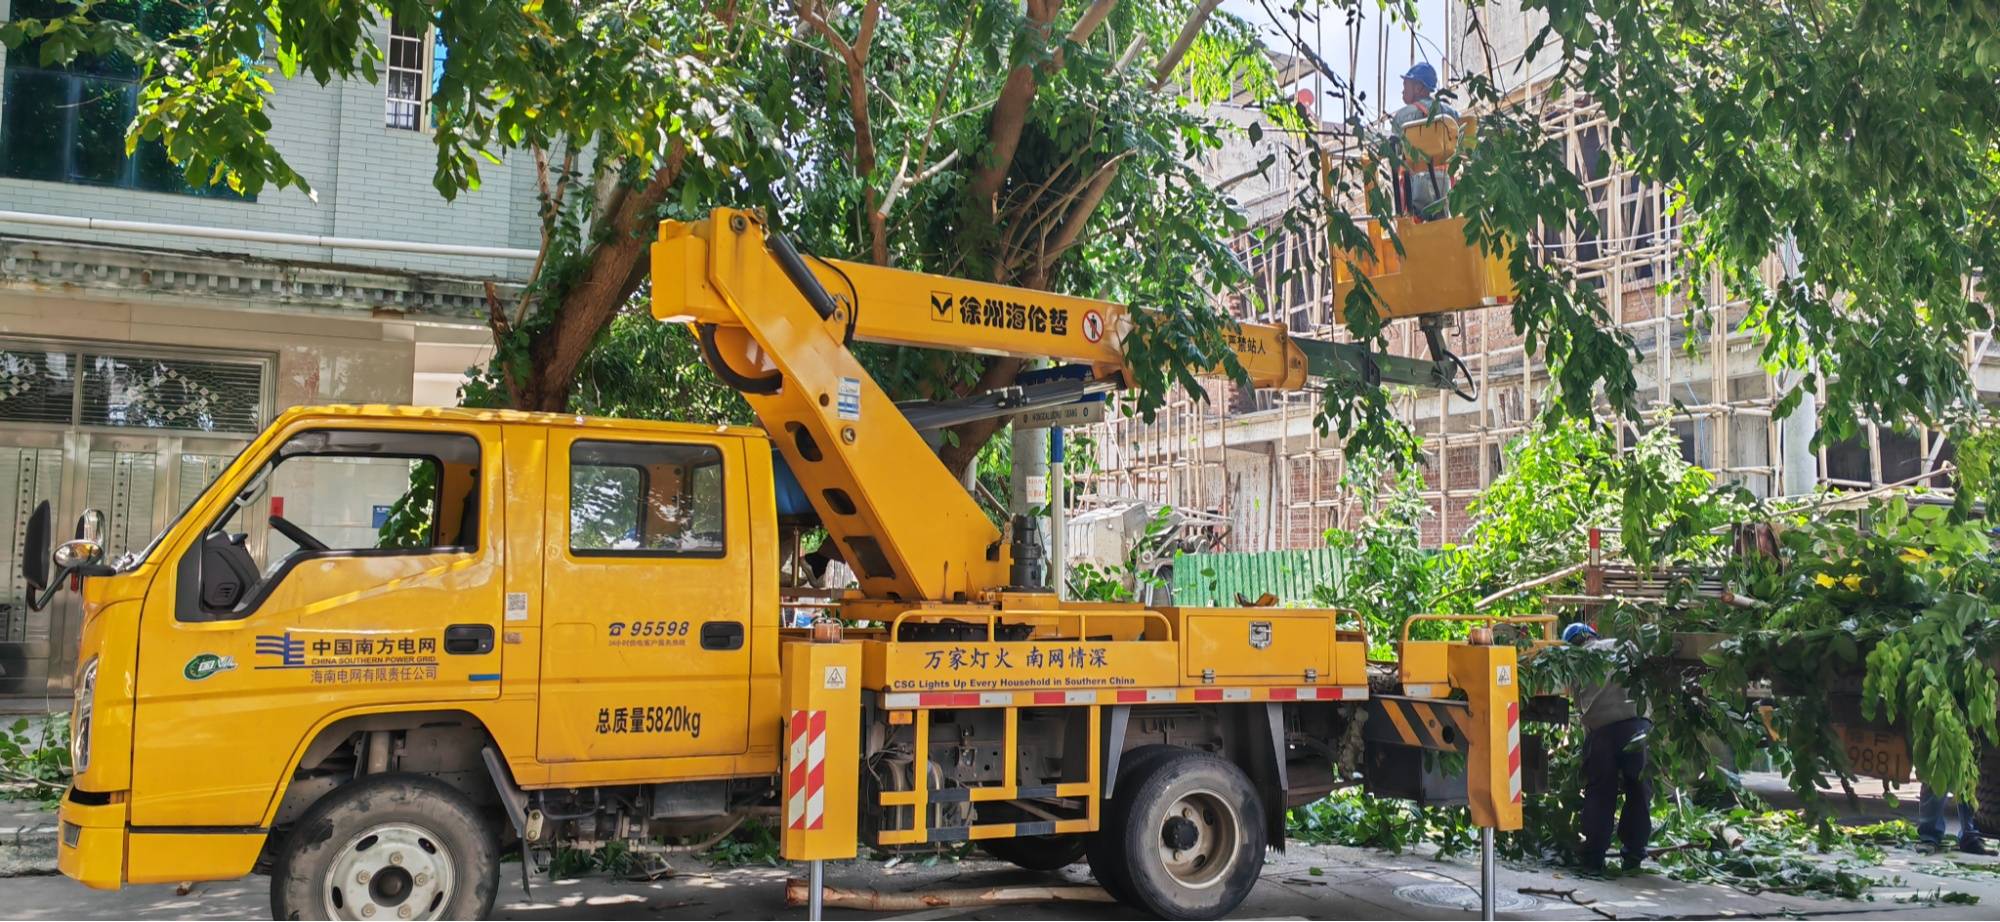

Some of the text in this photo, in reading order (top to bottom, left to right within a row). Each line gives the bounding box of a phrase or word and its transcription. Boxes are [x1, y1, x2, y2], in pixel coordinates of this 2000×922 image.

[959, 295, 1068, 336] 徐州海伦哲
[630, 621, 690, 636] 95598
[312, 637, 436, 656] 中国南方电网
[924, 645, 1108, 670] 万家灯火 南网情深
[311, 666, 437, 683] 海南电网有限责任公司
[894, 676, 1135, 689] CSG Lights Up Every Household in Southern China
[595, 705, 701, 738] 总质量5820kg
